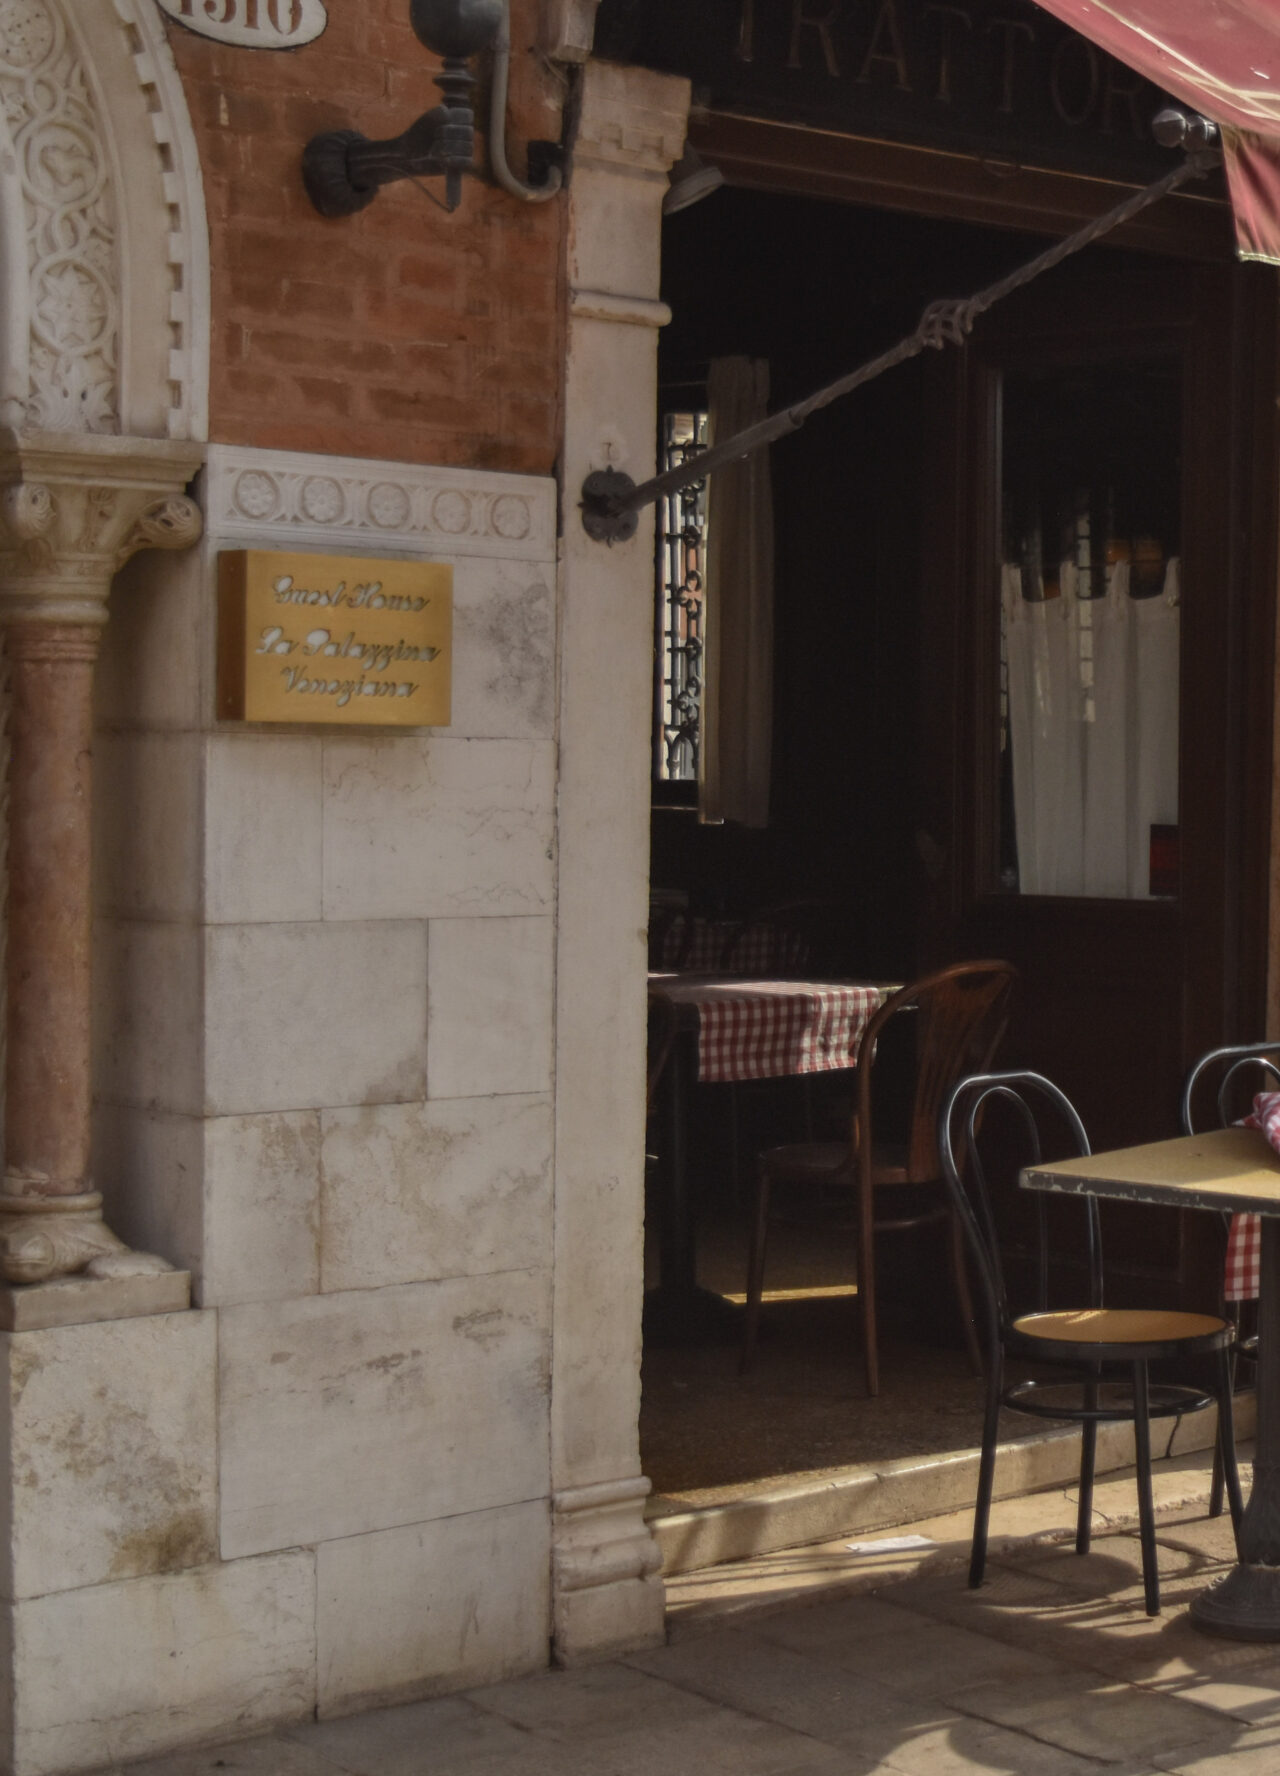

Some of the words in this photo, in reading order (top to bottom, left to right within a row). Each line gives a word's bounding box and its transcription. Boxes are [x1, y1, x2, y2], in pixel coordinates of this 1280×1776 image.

[272, 574, 348, 609] Guest
[346, 581, 431, 612] House
[255, 625, 300, 656] La
[302, 628, 442, 672] Palazzina
[280, 665, 420, 707] Veneziana
